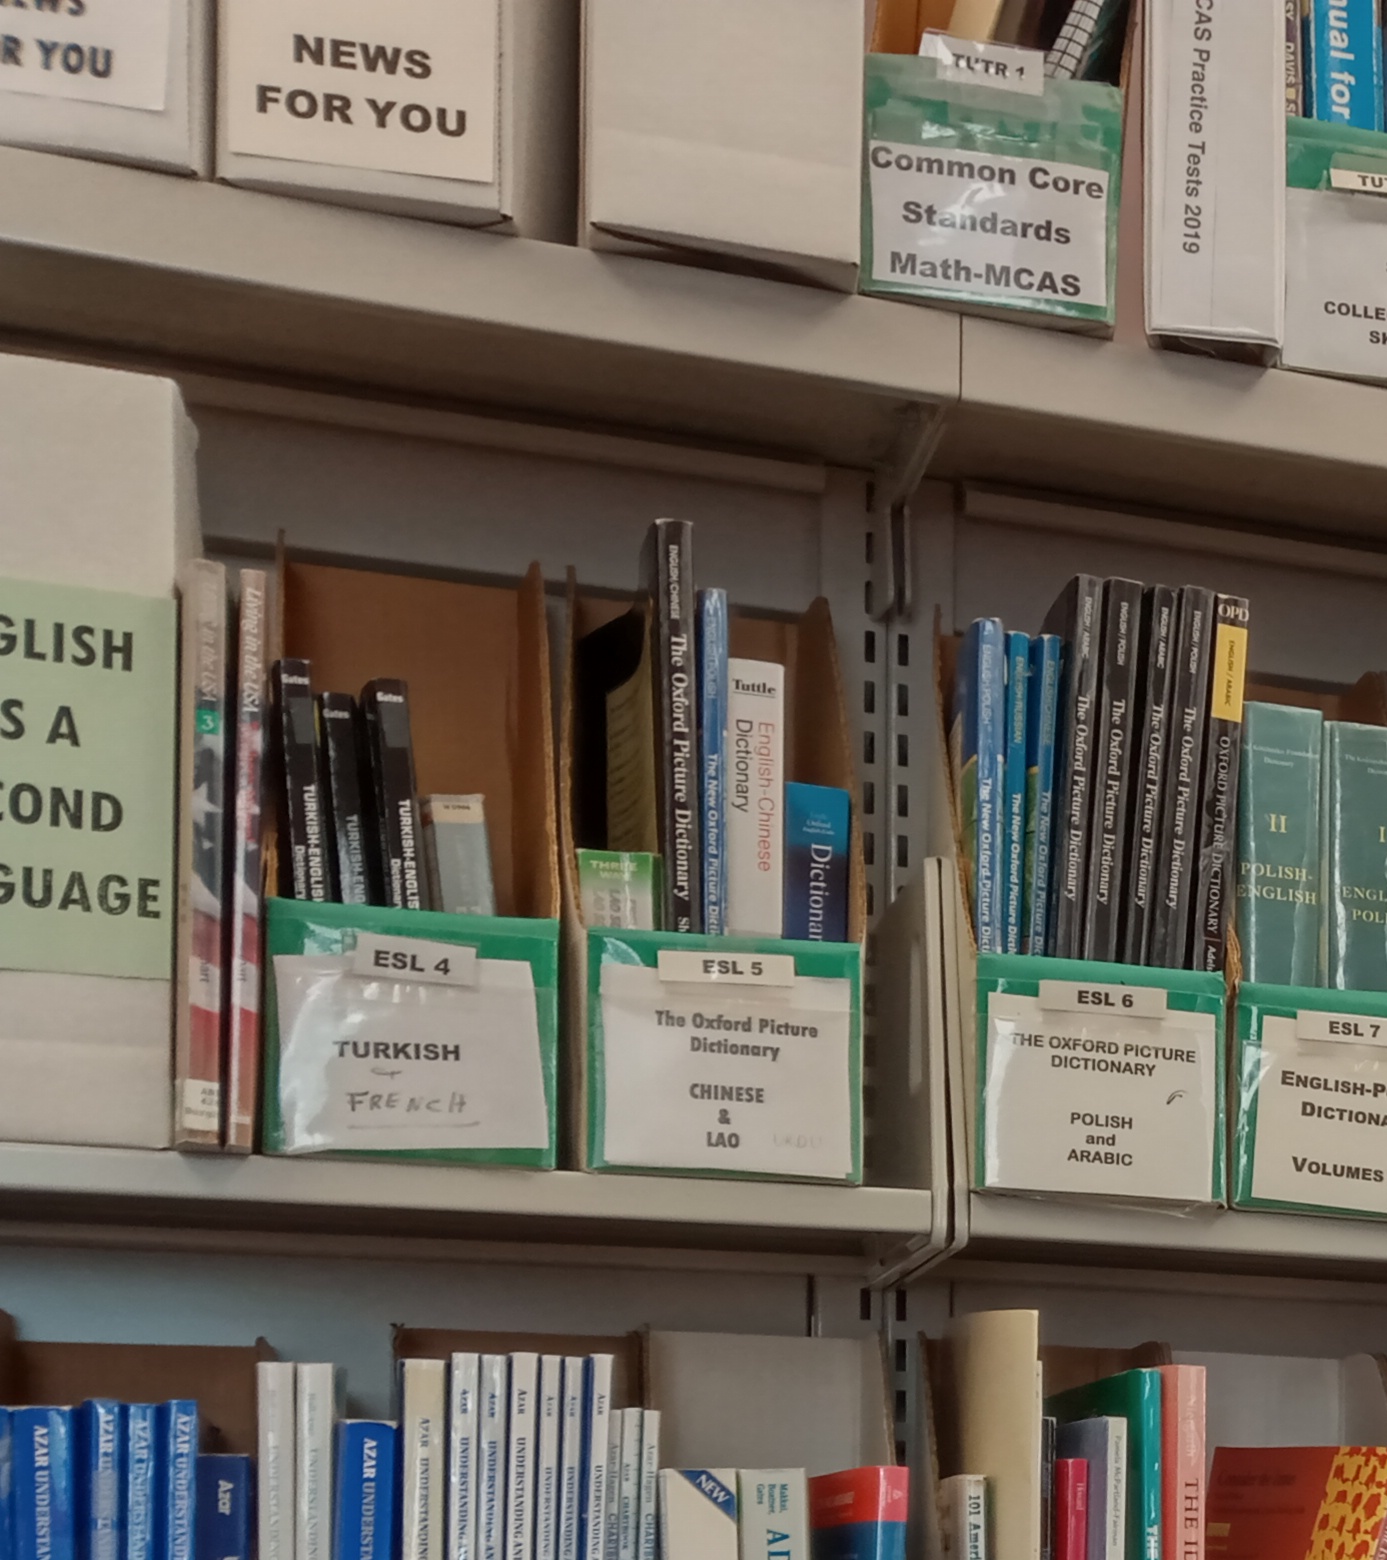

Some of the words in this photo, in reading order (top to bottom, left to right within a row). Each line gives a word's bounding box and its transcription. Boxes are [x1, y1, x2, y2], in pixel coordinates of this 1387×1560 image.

[294, 34, 431, 79] NEWS
[257, 85, 353, 124] FOR
[366, 99, 466, 137] YOU
[1189, 48, 1210, 133] Practice
[870, 145, 1017, 186] Common
[1029, 167, 1103, 199] Core
[1186, 141, 1205, 197] Tests
[902, 201, 1071, 244] Standards
[1183, 204, 1201, 254] 2019
[889, 251, 1080, 296] Math-MCAS
[733, 679, 775, 694] Tuttle
[45, 705, 81, 748] A
[374, 950, 424, 972] ESL
[434, 958, 450, 975] 4
[339, 1041, 460, 1061] TURKISH
[346, 1091, 466, 1113] FRENCH
[690, 1083, 764, 1103] CHINESE
[707, 1132, 740, 1148] LAO
[1071, 1112, 1132, 1129] POLISH
[1068, 1149, 1132, 1166] ARABIC
